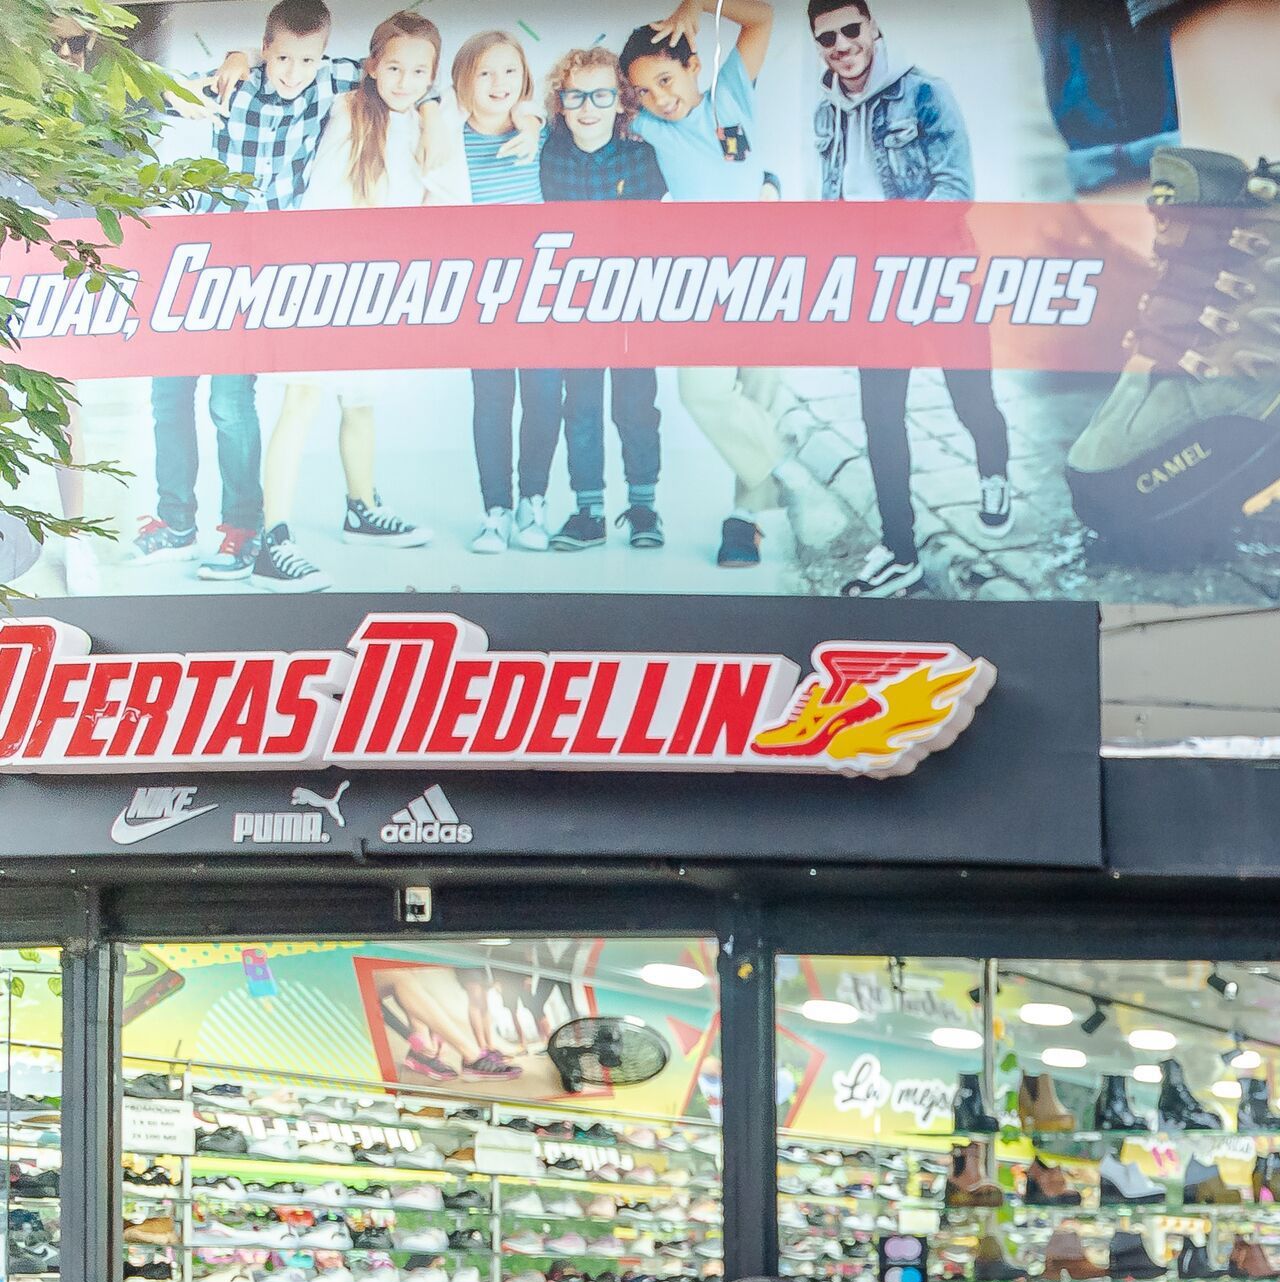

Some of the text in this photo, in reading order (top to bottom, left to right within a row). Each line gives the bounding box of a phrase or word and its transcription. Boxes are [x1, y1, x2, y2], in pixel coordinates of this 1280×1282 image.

[150, 241, 476, 333] COMODIDAD
[515, 231, 808, 325] ECONOMIA
[808, 255, 858, 323] A
[867, 256, 978, 327] TUS
[973, 256, 1104, 326] PIES
[1136, 442, 1212, 495] CAMEL
[0, 620, 773, 758] OFERTAS MEDELLIN
[127, 786, 199, 819] NIKE
[380, 820, 475, 845] adidas
